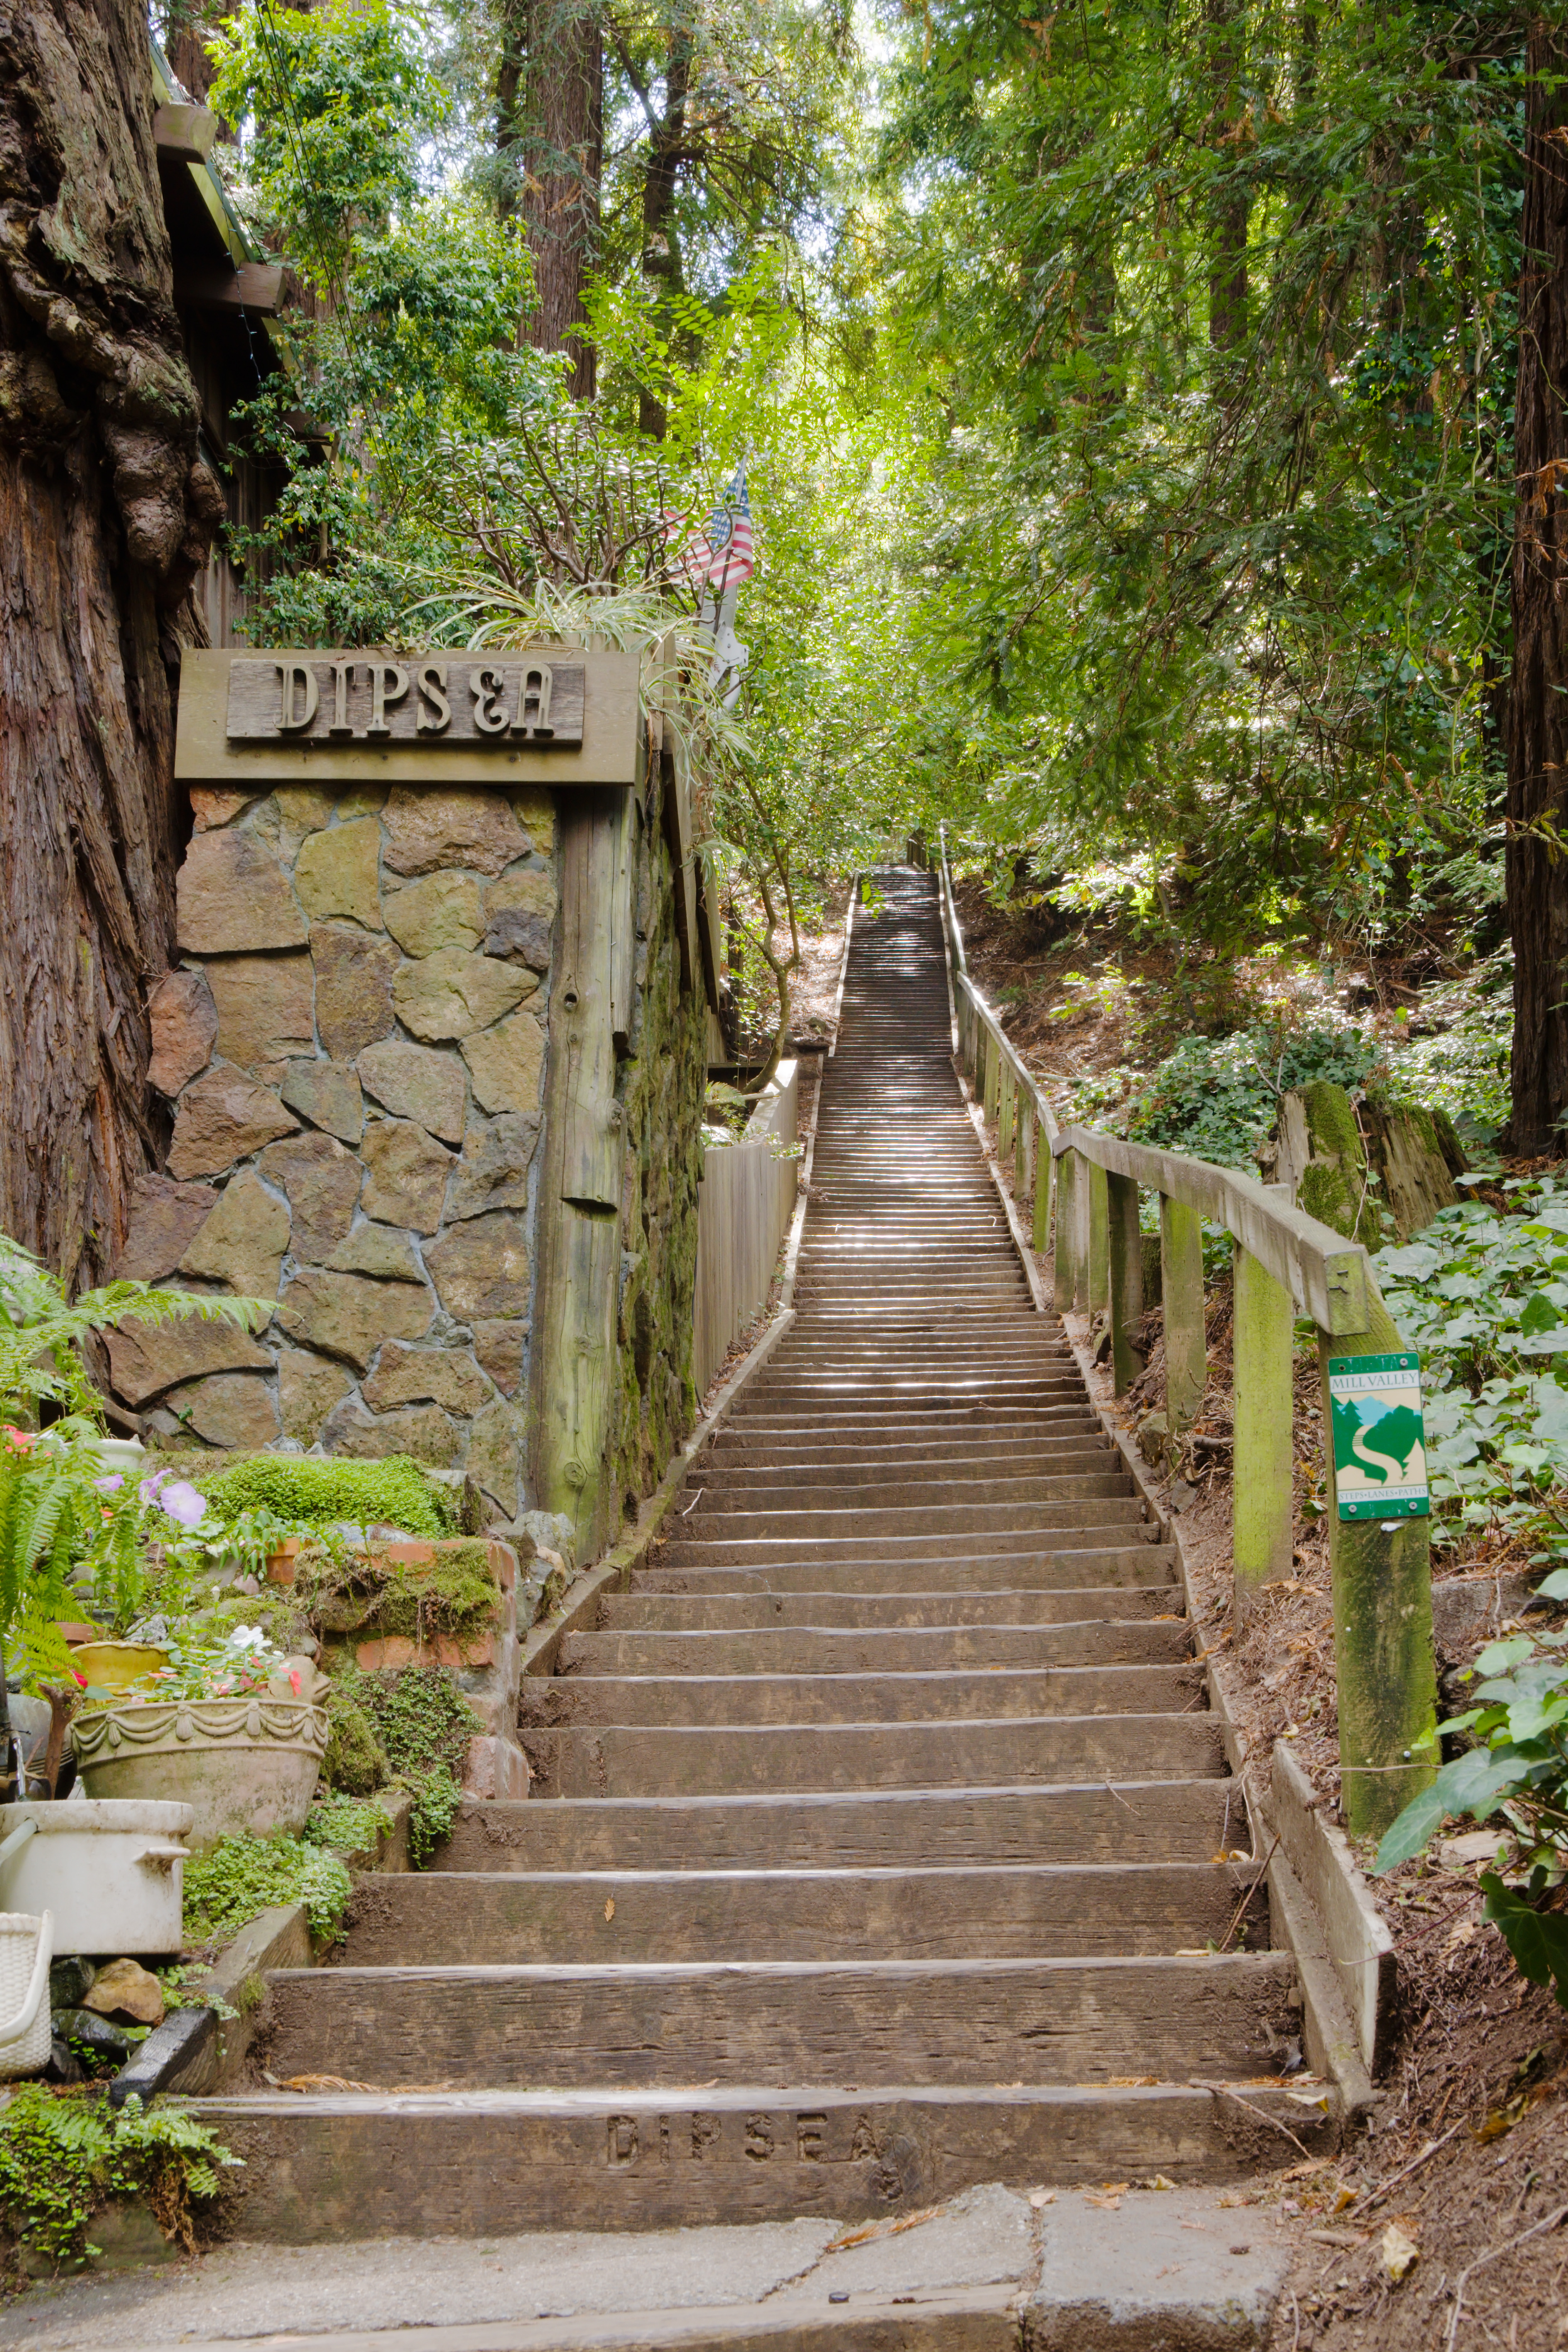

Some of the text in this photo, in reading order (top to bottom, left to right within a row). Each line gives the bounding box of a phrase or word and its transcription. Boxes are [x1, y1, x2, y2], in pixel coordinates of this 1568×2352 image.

[1332, 1373, 1417, 1389] MILL VALLEY
[608, 2111, 880, 2168] DIPSEA
